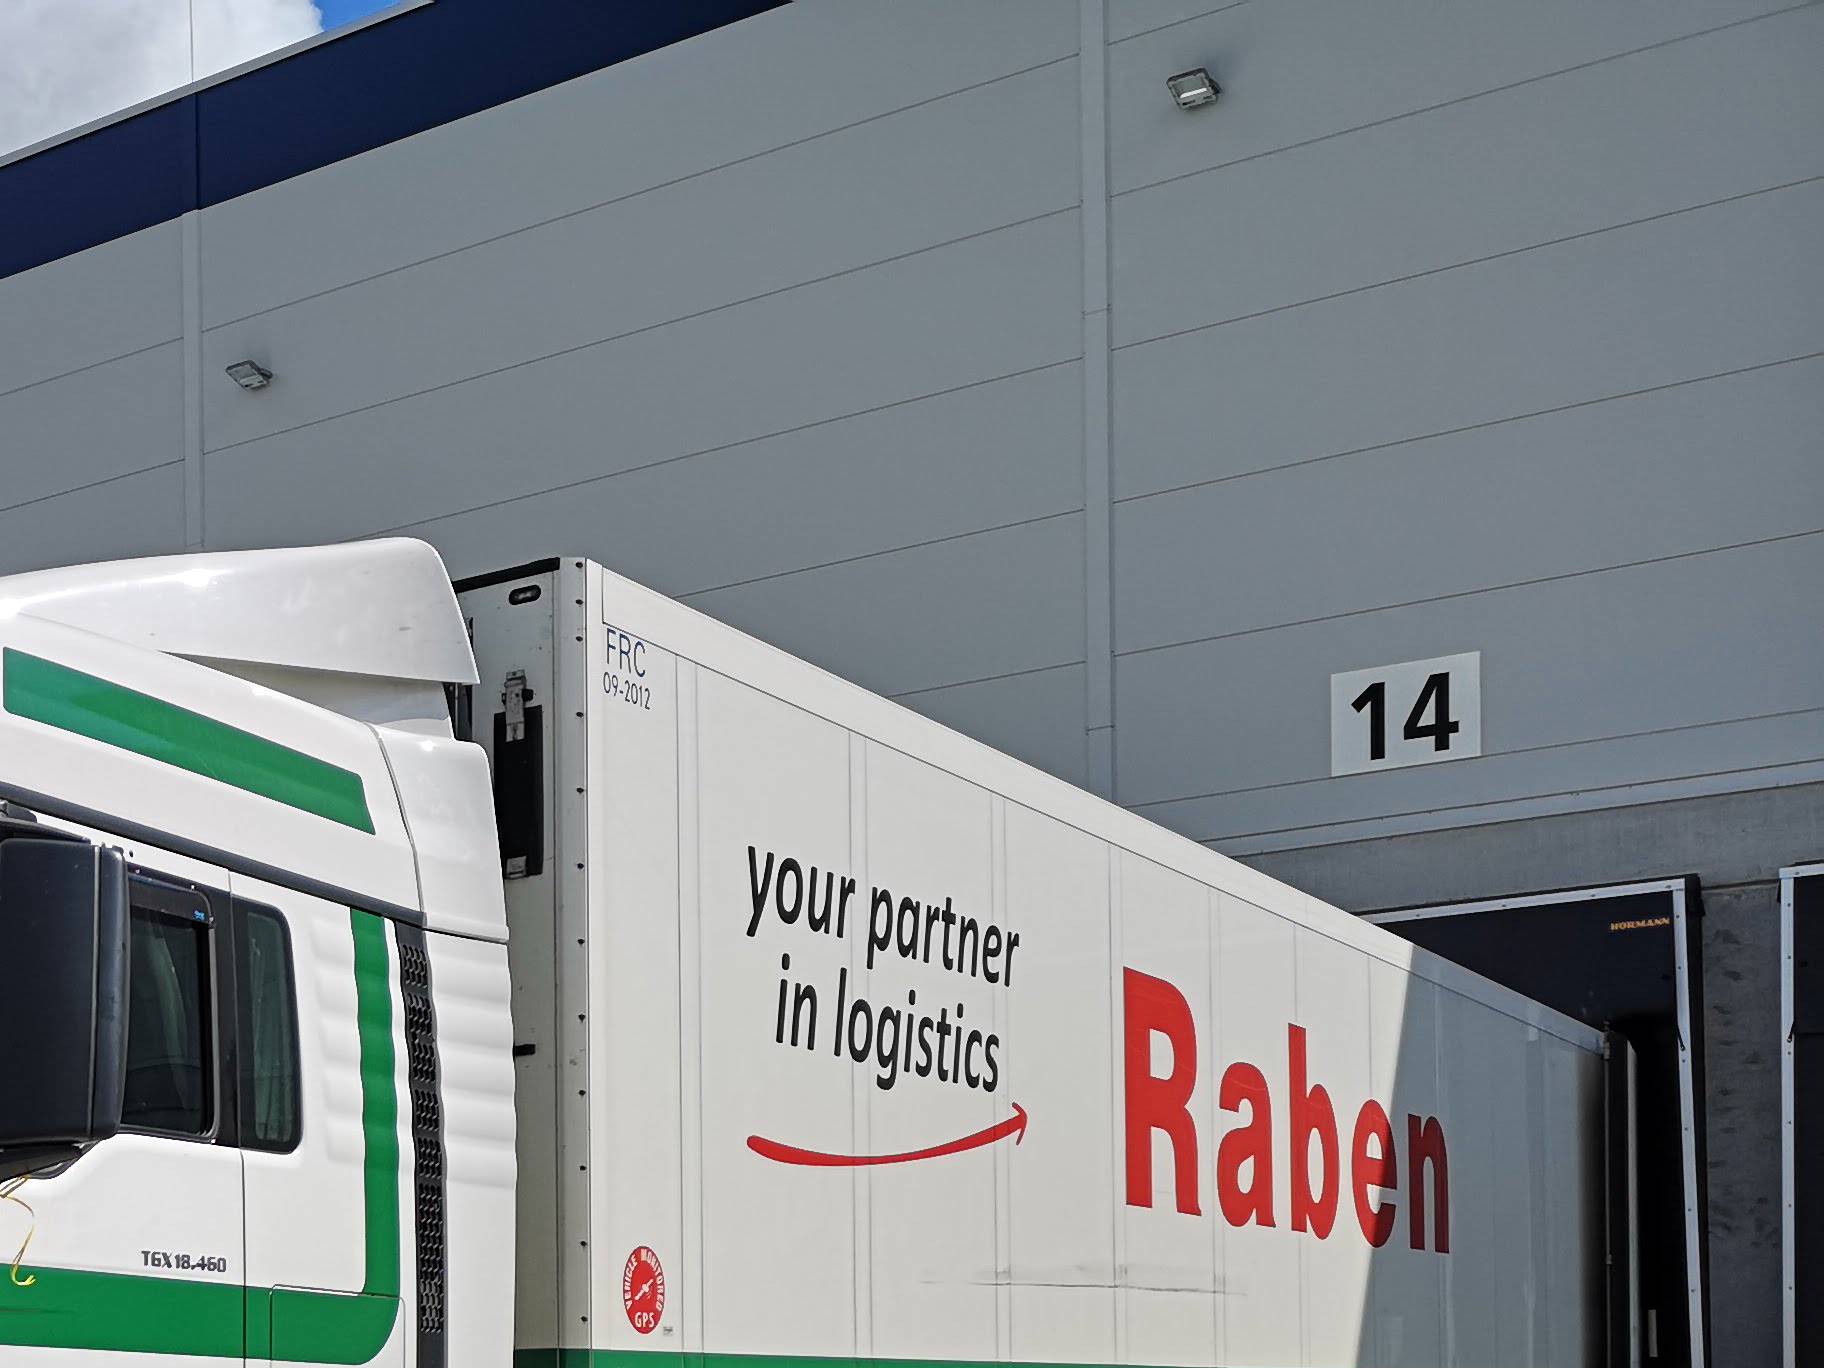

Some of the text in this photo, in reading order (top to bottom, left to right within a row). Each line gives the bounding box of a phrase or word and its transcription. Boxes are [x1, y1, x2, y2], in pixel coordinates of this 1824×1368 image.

[606, 627, 646, 678] FRC
[602, 671, 651, 710] 09-2012
[1350, 671, 1460, 761] 14
[745, 845, 1020, 988] your partner
[775, 952, 1001, 1093] in logistics
[1122, 965, 1450, 1255] Raben
[141, 1249, 172, 1270] TGX
[624, 1247, 664, 1313] VEHICLE MONITORED
[634, 1311, 656, 1328] GPS
